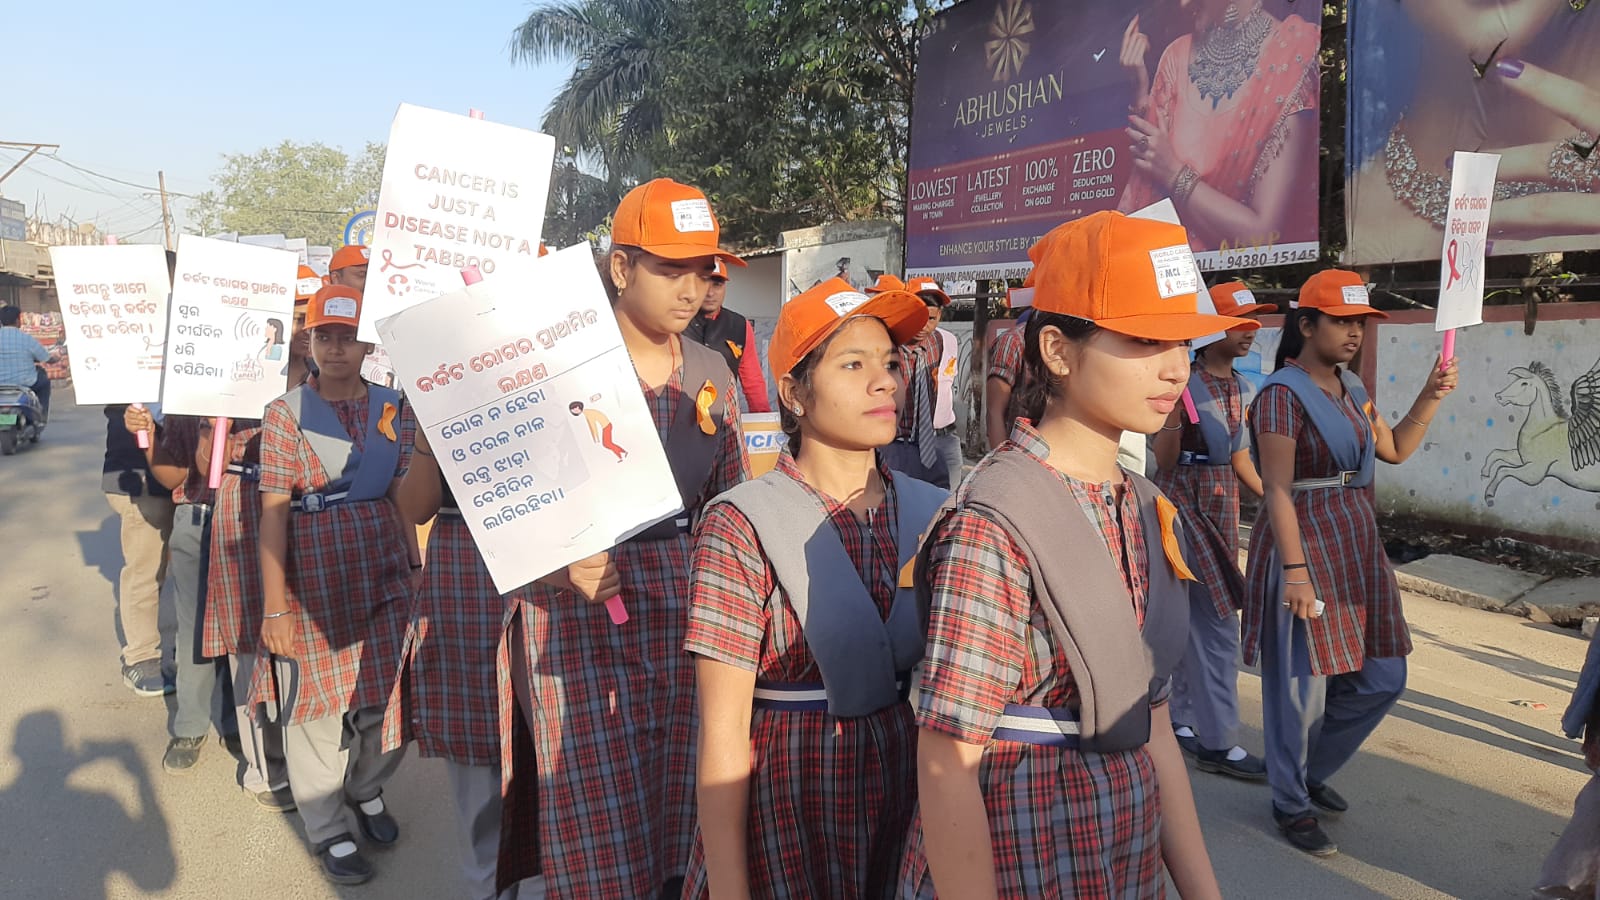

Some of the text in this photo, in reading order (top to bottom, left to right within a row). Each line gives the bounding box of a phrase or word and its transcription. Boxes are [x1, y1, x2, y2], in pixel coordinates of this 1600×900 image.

[953, 69, 1064, 129] ABHUSHAN
[981, 114, 1027, 138] JEWELS
[1025, 156, 1058, 182] 100%
[1072, 146, 1115, 174] ZERO
[414, 163, 519, 198] CANCER IS
[911, 176, 958, 201] LOWEST
[967, 165, 1012, 192] LATEST
[1022, 182, 1056, 195] EXCHANGE
[1072, 174, 1113, 188] DEDUCTION
[913, 199, 954, 211] MAKING CHARGES
[971, 201, 1004, 213] COLLECTION
[973, 191, 1002, 203] JEWELLERY
[1024, 196, 1052, 207] ON GOLD
[1069, 187, 1115, 202] ON OLD GOLD
[428, 194, 496, 222] JUST A
[923, 210, 943, 220] IN TOWN
[385, 211, 469, 243] DISEASE
[473, 229, 515, 251] NOT
[517, 239, 531, 255] A
[413, 244, 496, 274] TABBOO
[939, 242, 972, 256] ENHANCE
[974, 239, 994, 253] YOUR
[995, 238, 1018, 252] STYLE
[1020, 237, 1030, 249] BY
[1196, 258, 1215, 271] ALL
[1227, 253, 1267, 268] 94380
[1272, 249, 1316, 264] 15145
[416, 308, 598, 392] କର୍କଟ ରୋଗର ପ୍ରାଥମିକ
[497, 362, 549, 393] ଲକ୍ଷଣ
[441, 388, 546, 439] ଭୋକ ନ ହେବା
[452, 417, 545, 462] ଓ ତରଳ ନାଳ
[462, 466, 492, 486] ରକ୍ତ
[473, 474, 534, 508] ବେଶିଦିନ
